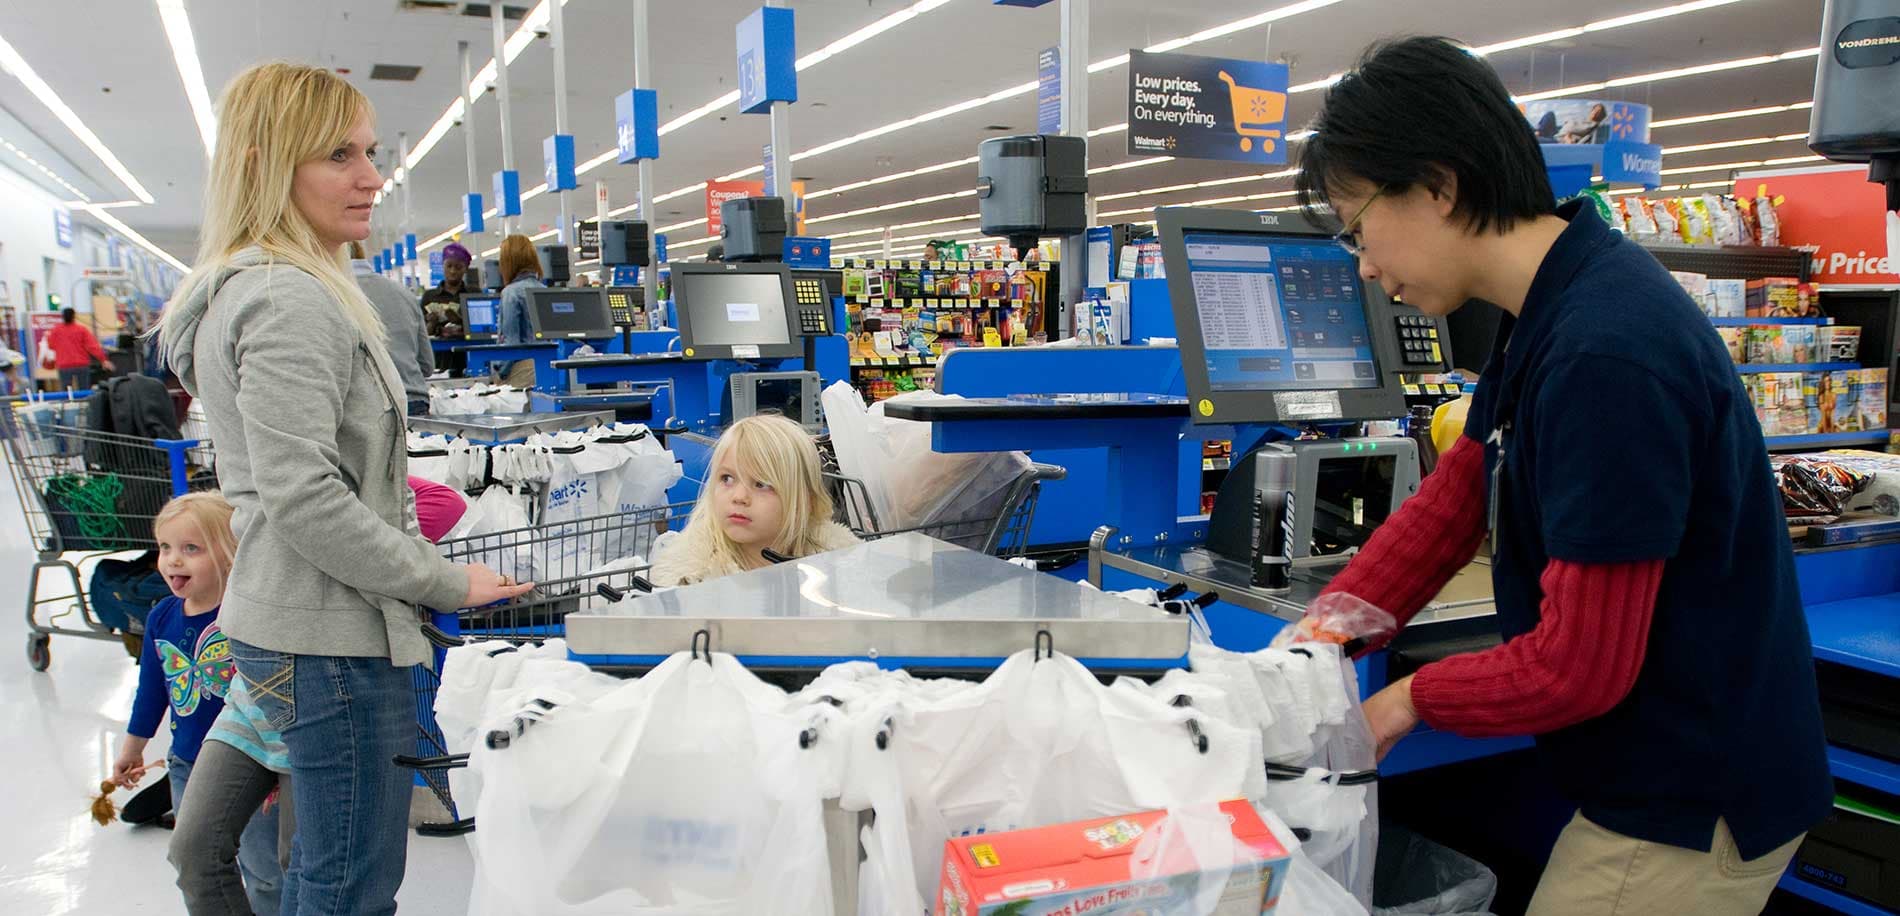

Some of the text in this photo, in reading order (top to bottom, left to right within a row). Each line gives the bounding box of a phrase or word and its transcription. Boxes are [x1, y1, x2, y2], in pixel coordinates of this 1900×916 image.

[1839, 36, 1900, 49] VONDREHL
[741, 58, 754, 98] 13
[1135, 73, 1201, 92] Low prices.
[1135, 90, 1196, 110] Every day.
[1134, 105, 1216, 128] On everything.
[1134, 136, 1166, 147] Walmart
[1260, 215, 1279, 225] IBM
[1074, 894, 1105, 913] Love
